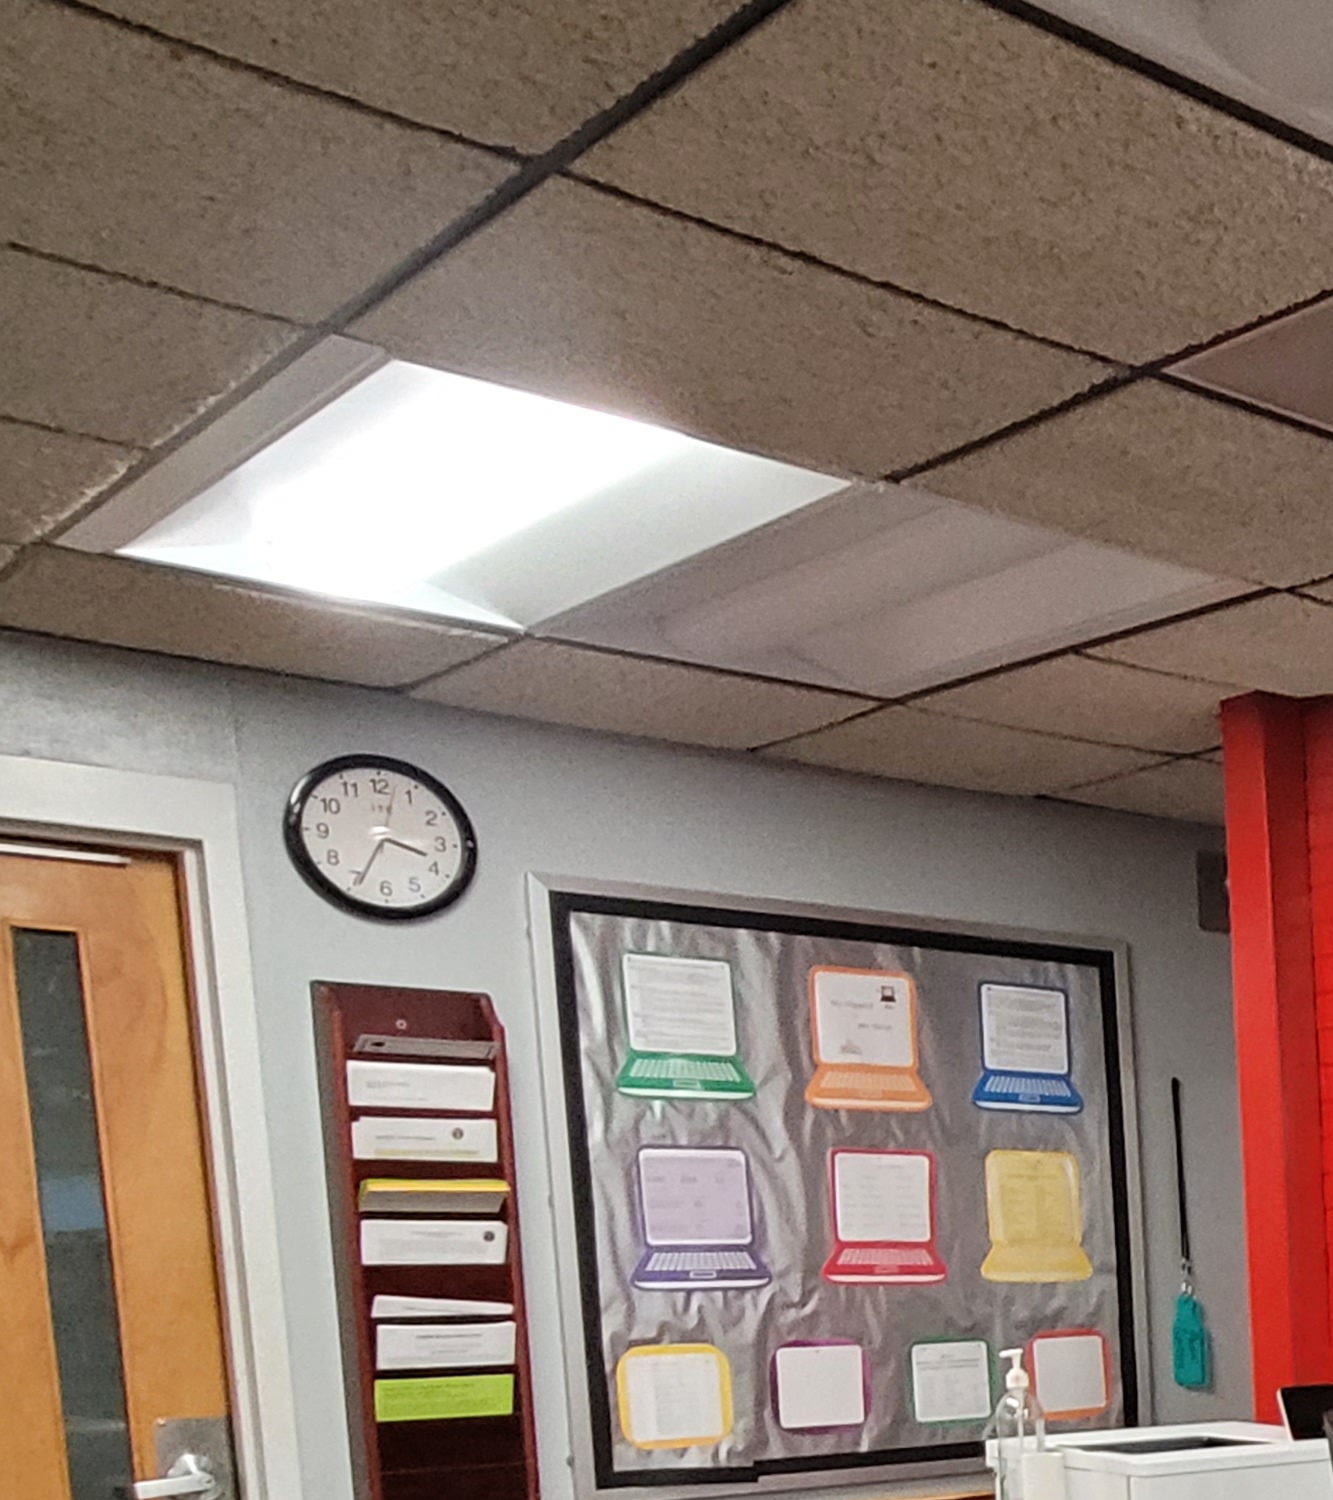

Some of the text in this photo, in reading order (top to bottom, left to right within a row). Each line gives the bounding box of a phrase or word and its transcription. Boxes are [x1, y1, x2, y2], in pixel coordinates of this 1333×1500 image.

[342, 781, 359, 797] 11
[369, 778, 390, 795] 12
[321, 797, 341, 814] 10
[405, 790, 413, 805] 1
[425, 810, 437, 826] 2
[316, 823, 330, 839] 9
[434, 836, 446, 852] 3
[326, 849, 340, 866] 8
[428, 861, 440, 875] 4
[348, 870, 361, 886] 7
[408, 877, 421, 892] 5
[379, 880, 393, 896] 6
